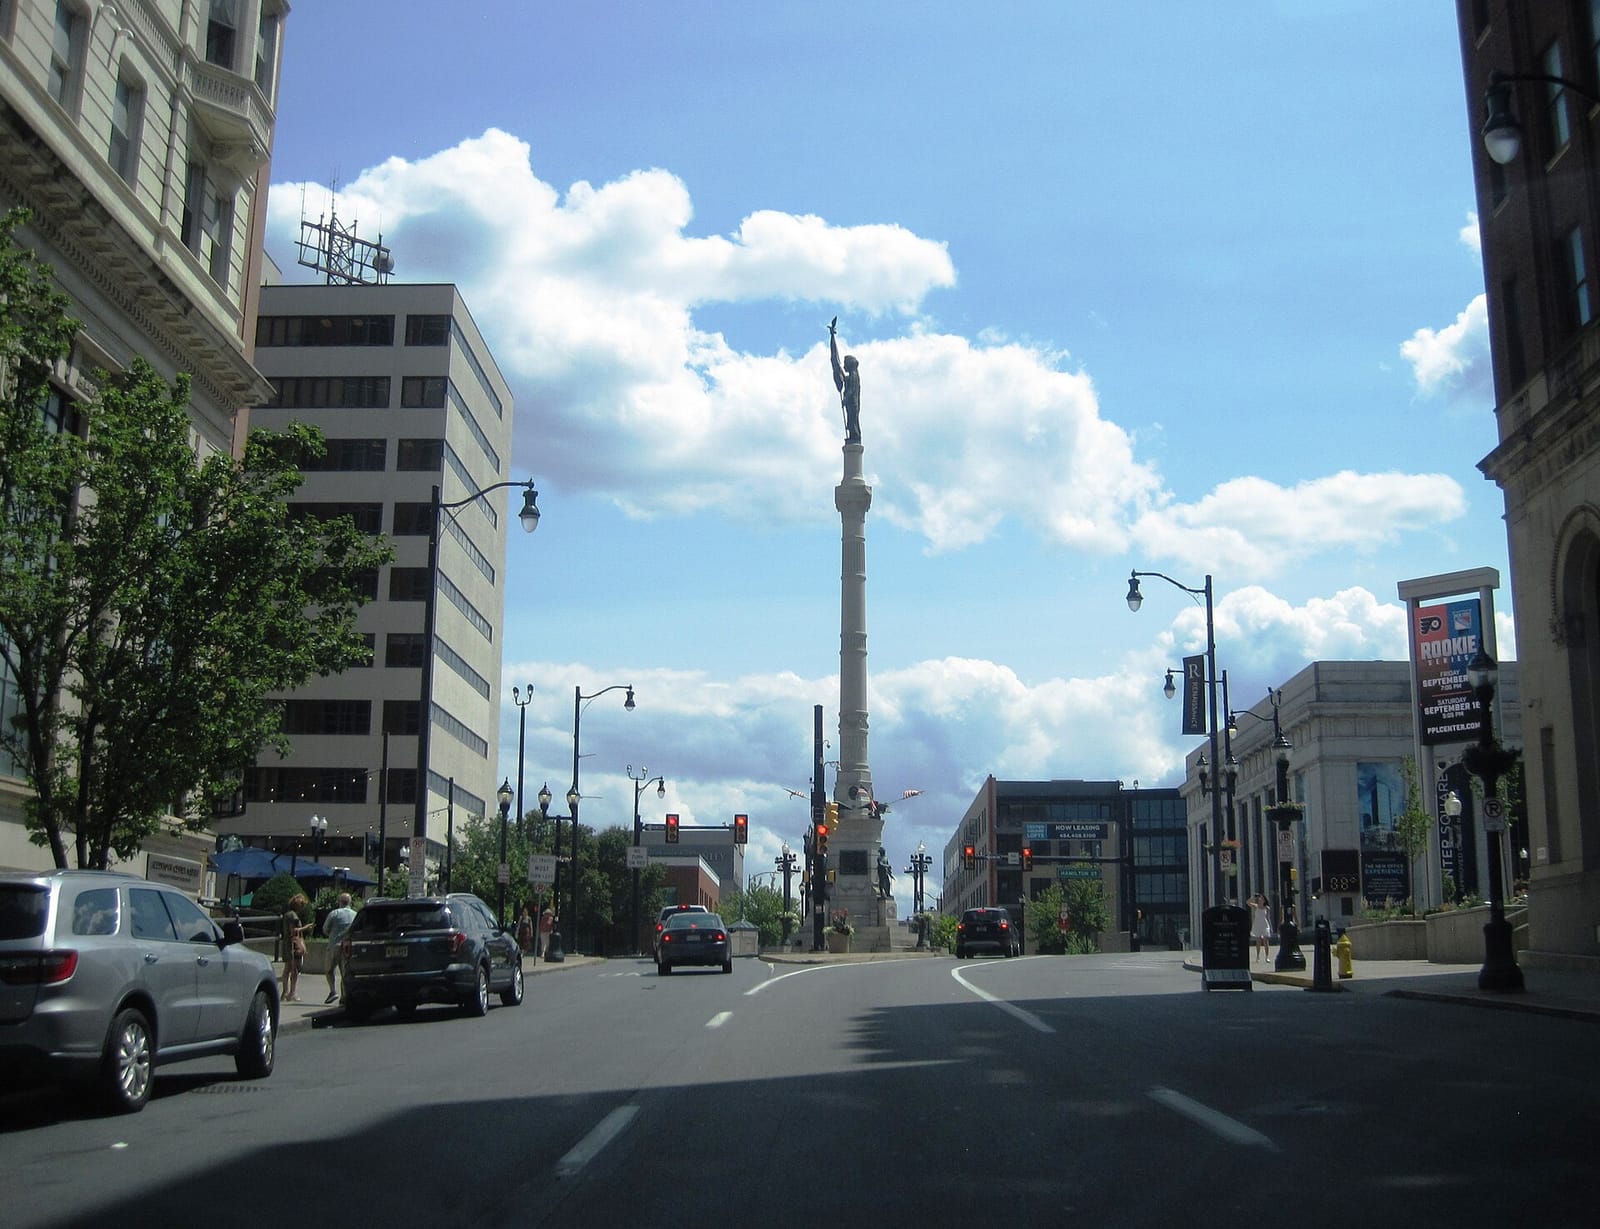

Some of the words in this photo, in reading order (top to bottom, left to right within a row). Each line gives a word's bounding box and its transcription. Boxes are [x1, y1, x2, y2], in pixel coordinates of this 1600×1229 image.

[1421, 635, 1477, 660] ROOKIE
[1427, 654, 1469, 666] SERIES
[1187, 663, 1200, 679] R
[1440, 670, 1460, 678] FRIDAY
[1422, 674, 1469, 687] SEPTEMBER
[1437, 697, 1467, 706] SATURDAY
[1424, 702, 1470, 715] SEPTEMBER
[1427, 722, 1481, 734] PPLCENTER.COM
